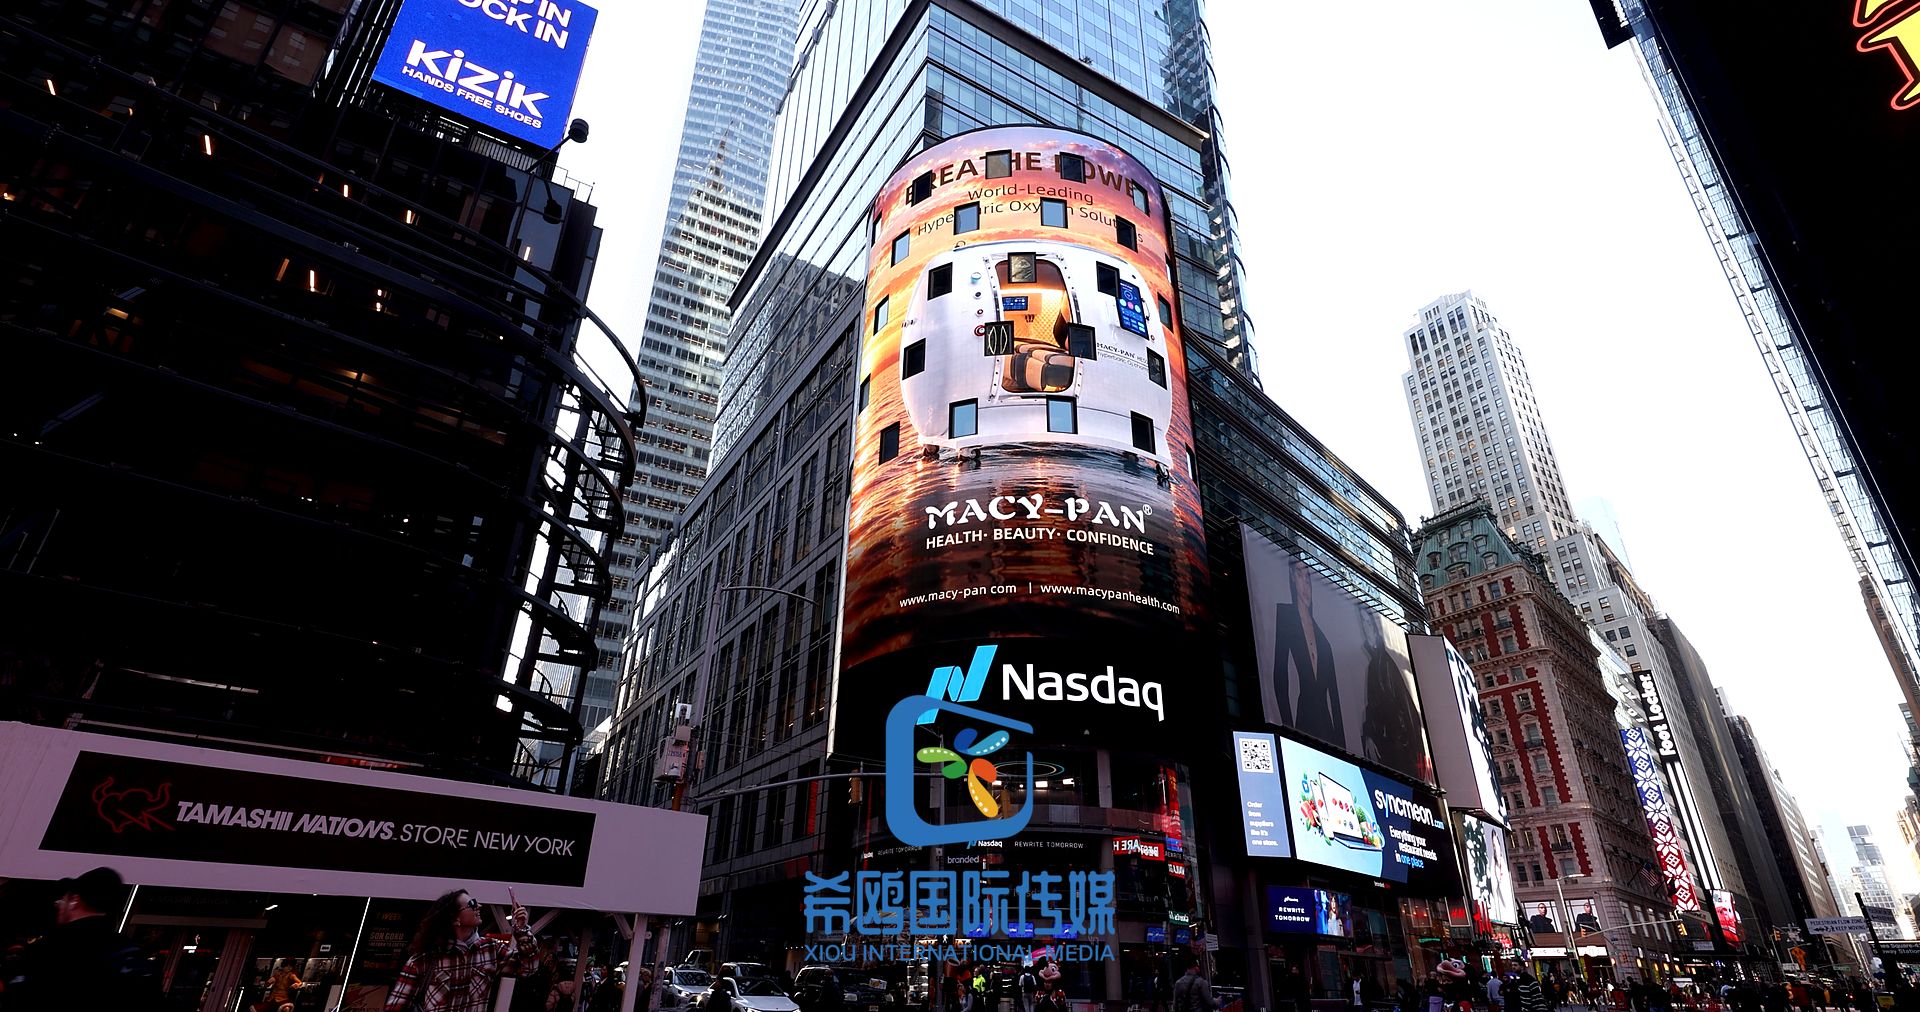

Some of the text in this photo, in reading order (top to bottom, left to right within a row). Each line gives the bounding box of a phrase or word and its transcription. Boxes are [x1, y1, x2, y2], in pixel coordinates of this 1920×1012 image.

[534, 19, 569, 50] IN
[402, 65, 542, 129] HANDS FREE SHOES
[968, 183, 1094, 206] World-Leading
[1066, 529, 1154, 556] CONFIDENCE
[1040, 584, 1180, 614] www.macypanhealth.com
[1002, 663, 1165, 722] Nasdaq
[1638, 673, 1677, 756] Foot Locker
[176, 800, 294, 832] TAMASHII
[400, 823, 469, 849] STORE
[473, 830, 521, 851] NEW
[524, 835, 576, 857] YORK
[978, 839, 1003, 848] Nasdaq
[1046, 841, 1084, 849] TOMORROW
[947, 855, 980, 865] branded
[1275, 914, 1310, 922] TOMORROW
[1278, 906, 1305, 914] REWRITE
